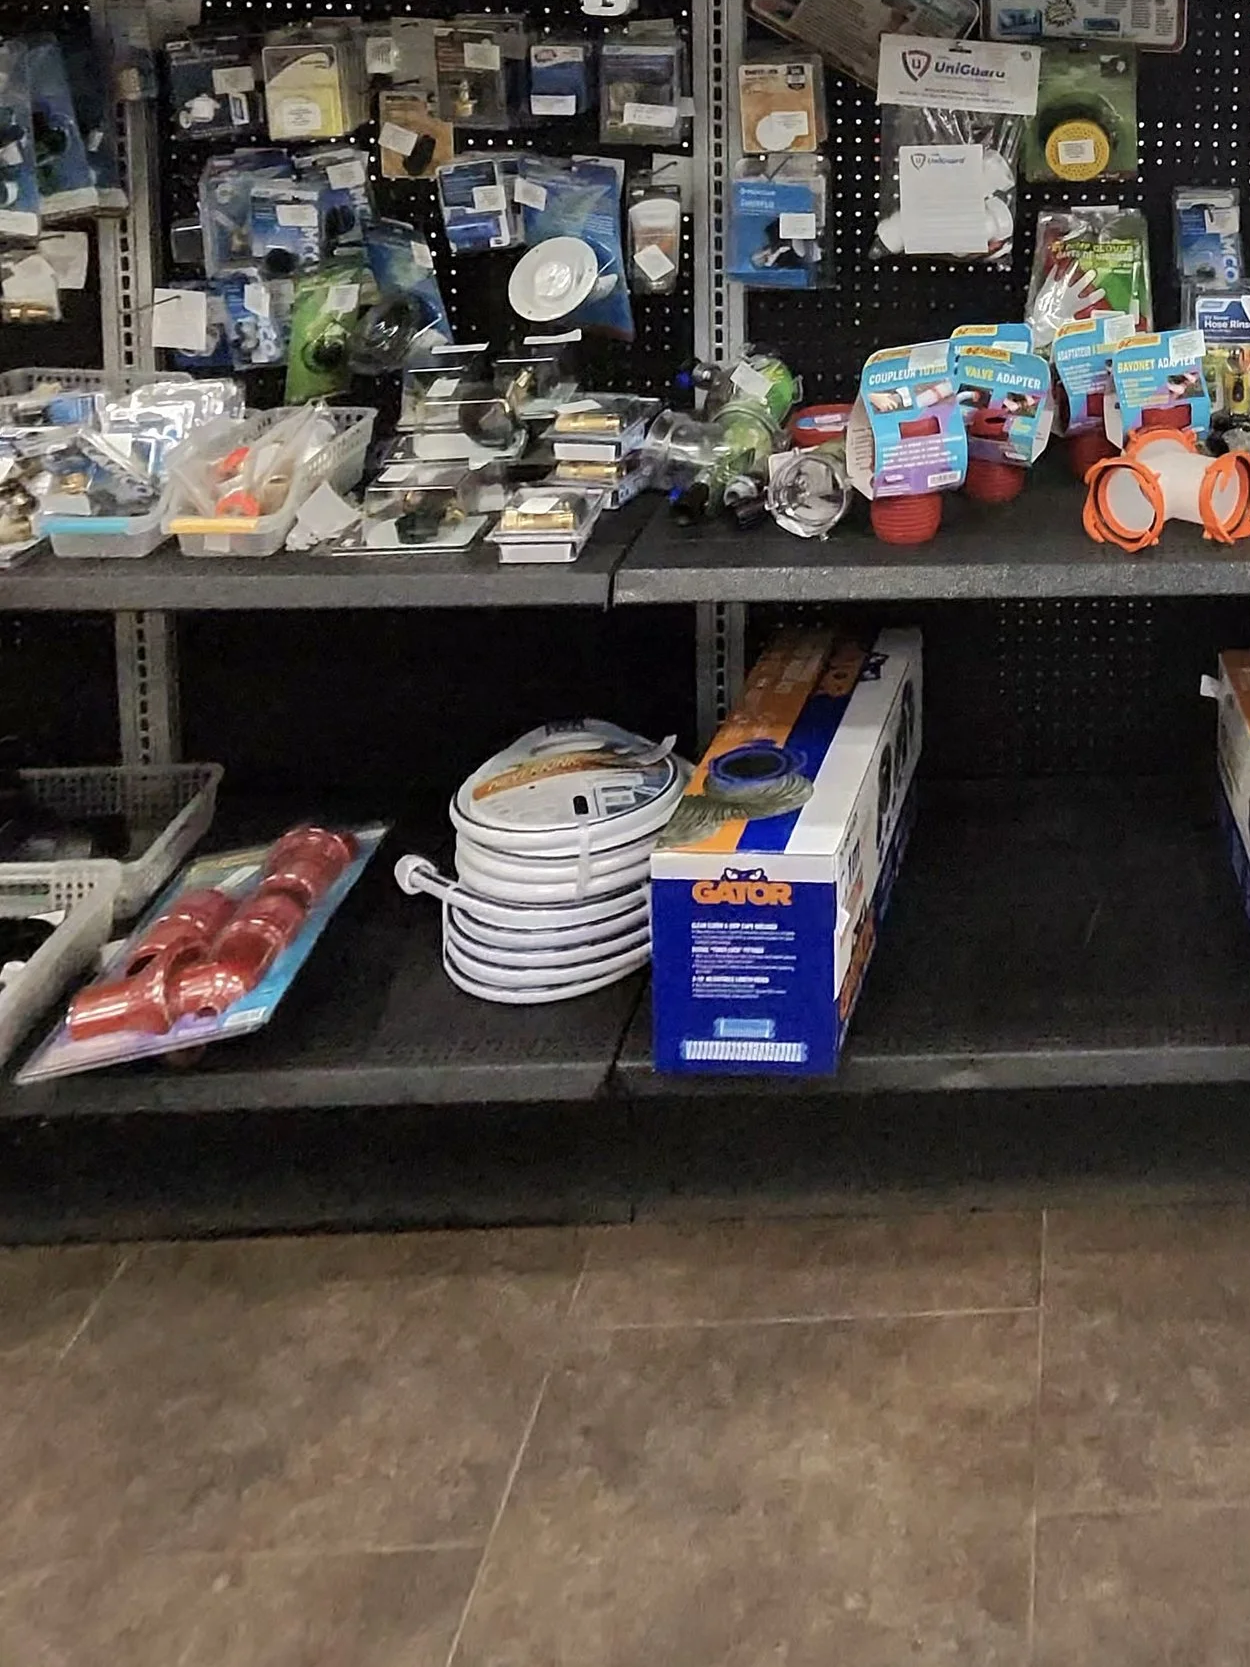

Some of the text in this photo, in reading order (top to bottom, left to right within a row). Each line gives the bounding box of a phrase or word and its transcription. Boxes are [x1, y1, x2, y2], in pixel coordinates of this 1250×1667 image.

[1204, 320, 1228, 330] Hose
[1117, 359, 1155, 374] BAYONET
[965, 365, 1041, 389] VALVE ADAPTER
[691, 881, 793, 906] GATOR
